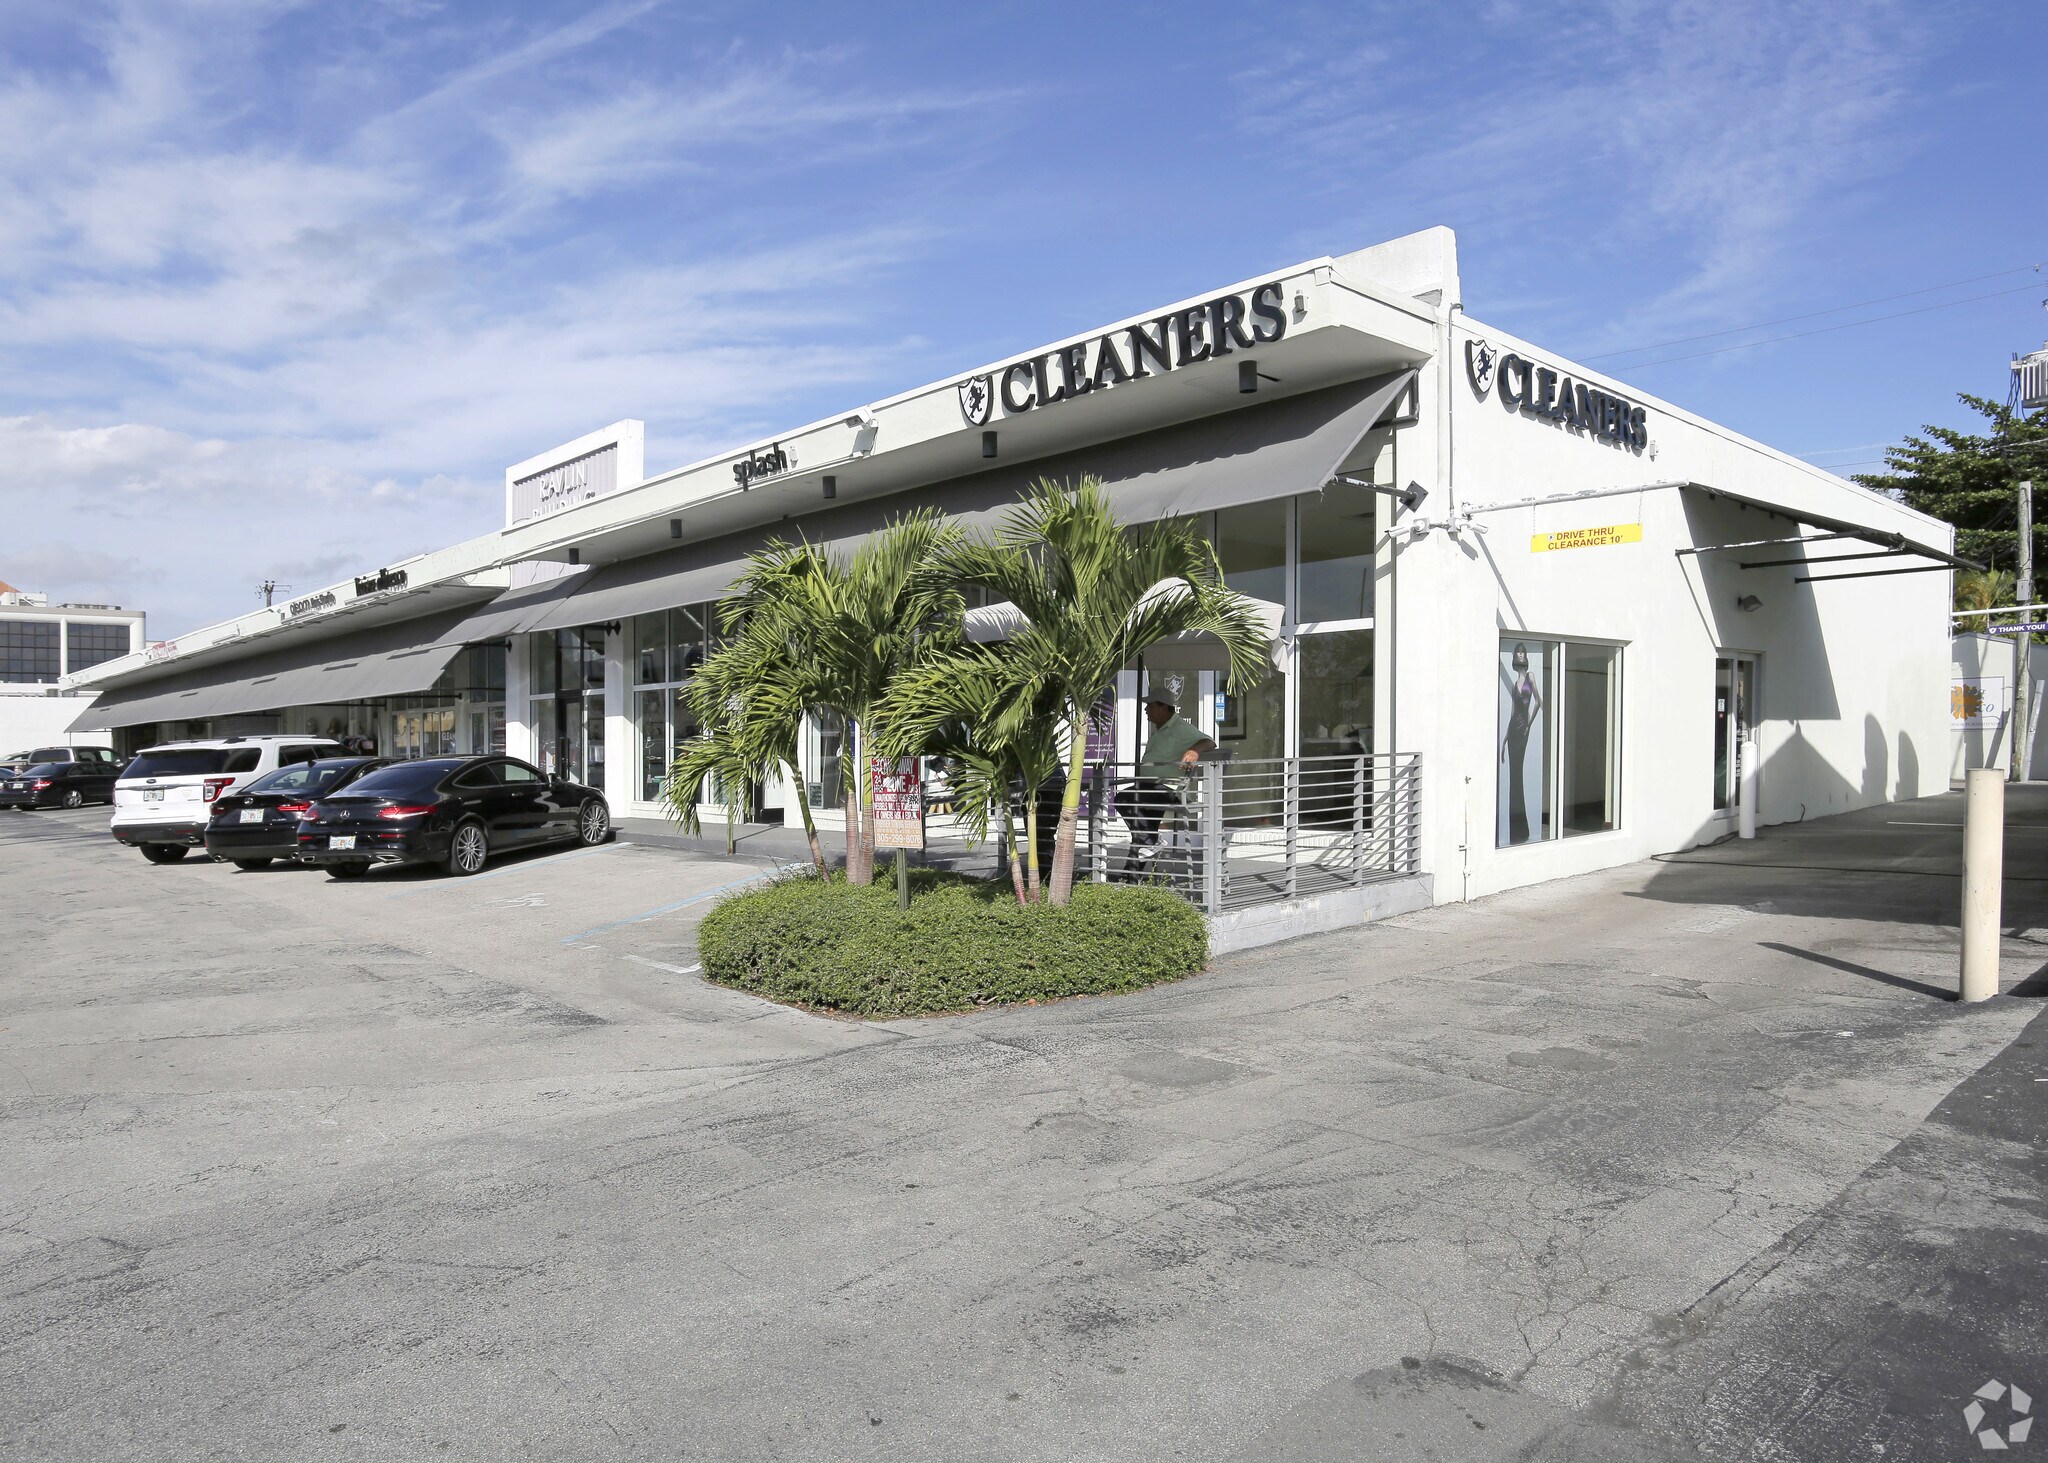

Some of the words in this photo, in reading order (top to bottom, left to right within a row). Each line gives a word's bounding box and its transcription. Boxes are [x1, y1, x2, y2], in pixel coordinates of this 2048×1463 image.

[1001, 283, 1287, 413] CLEANERS
[1497, 353, 1648, 450] CLEANERS
[540, 463, 586, 500] RAVLIN
[733, 442, 788, 491] splash
[1548, 537, 1607, 550] CLEARANCE
[1556, 530, 1585, 541] DRIVE
[1588, 527, 1614, 537] THRU
